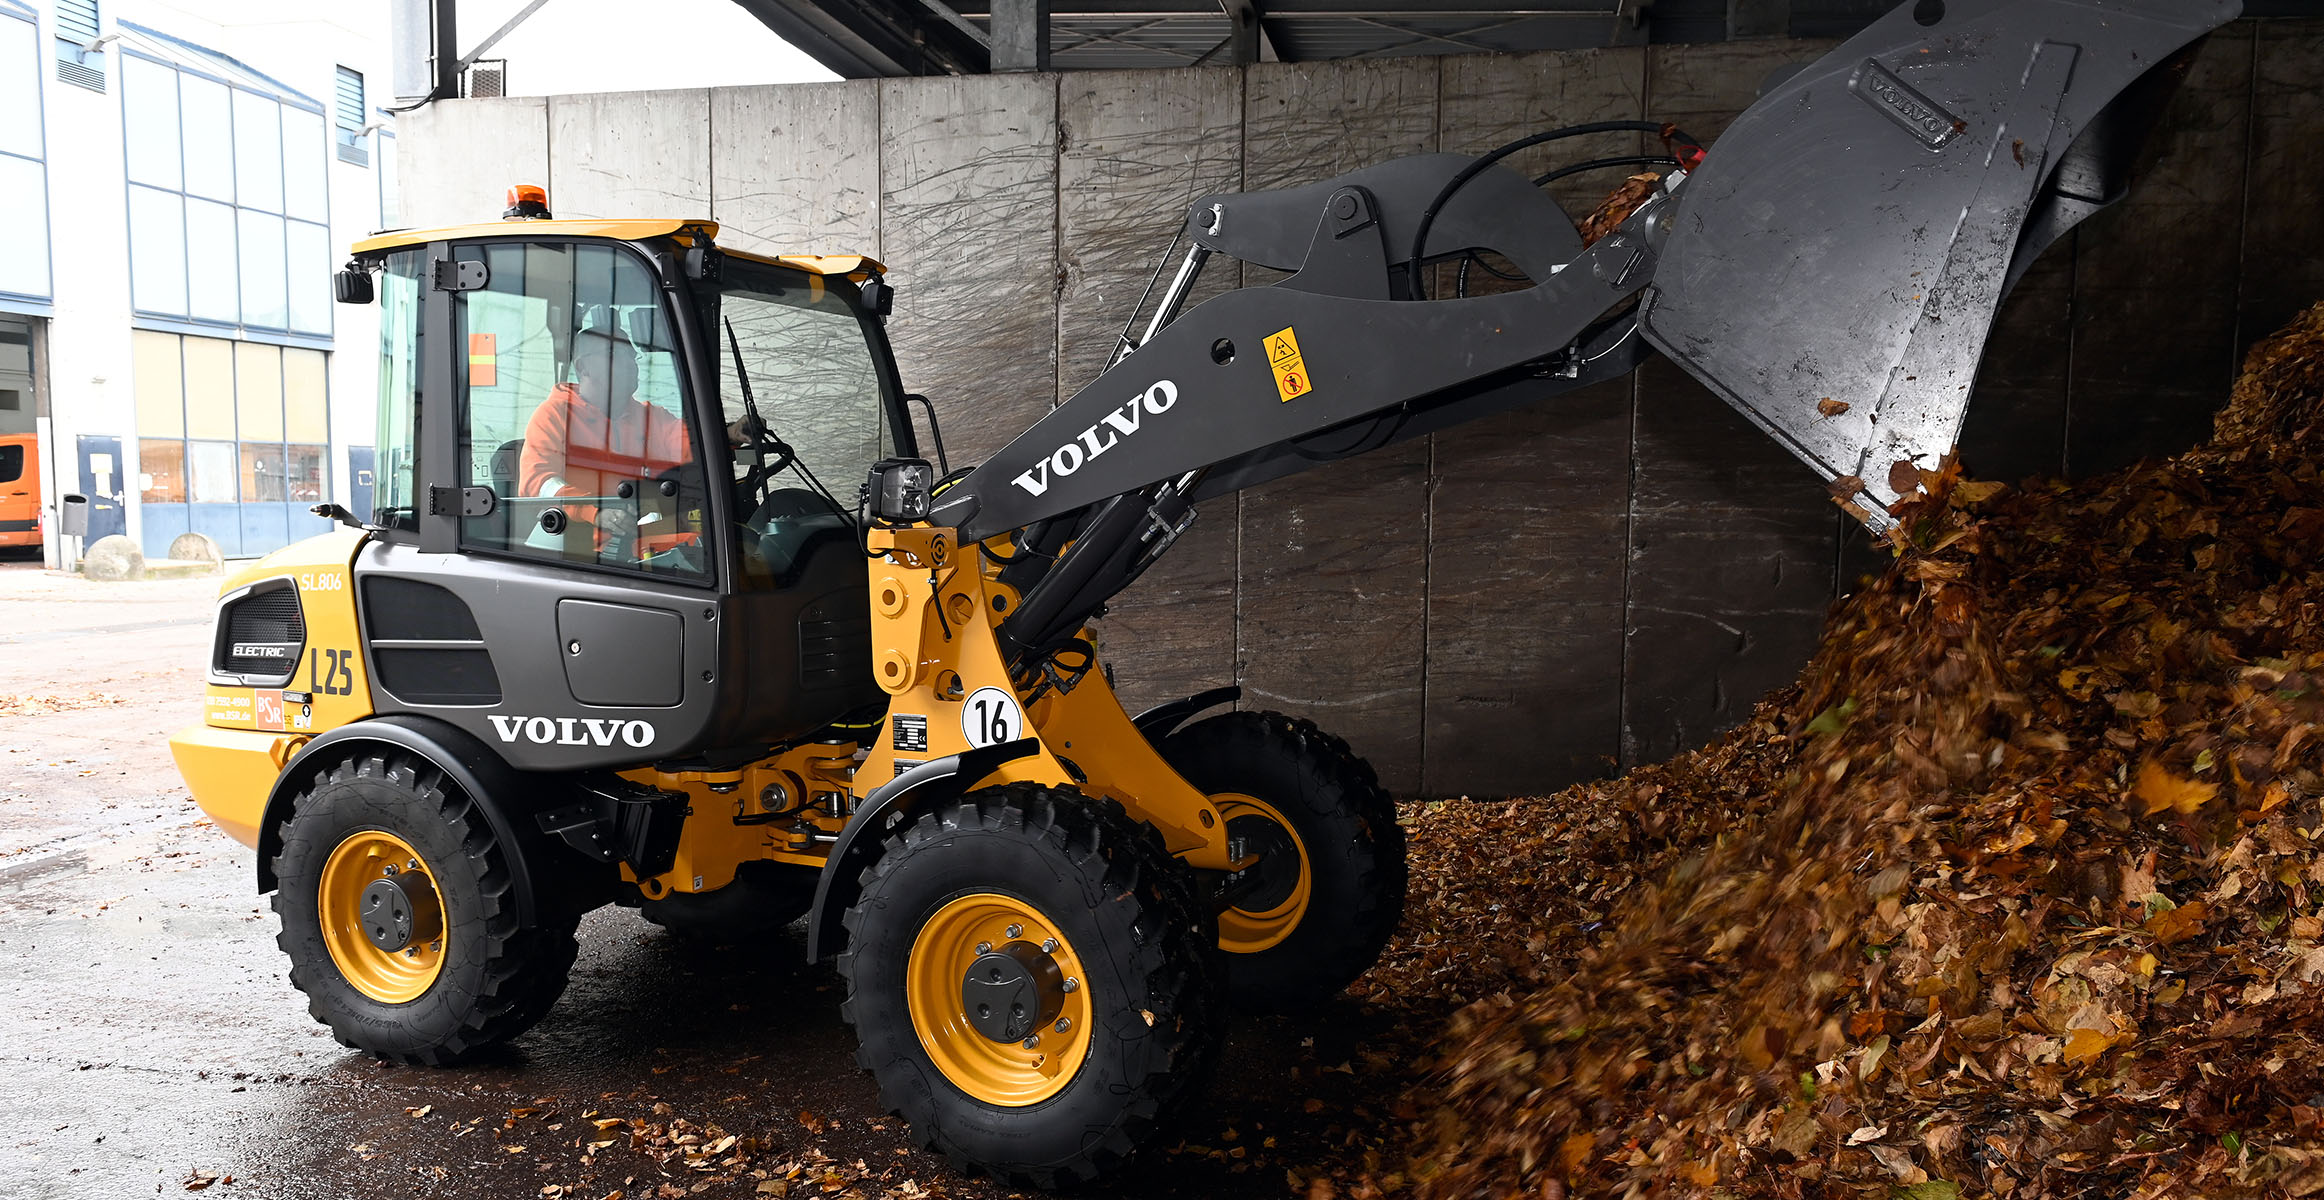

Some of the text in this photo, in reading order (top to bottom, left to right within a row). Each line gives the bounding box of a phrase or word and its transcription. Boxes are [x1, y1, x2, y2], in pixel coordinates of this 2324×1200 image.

[1869, 74, 1941, 132] VOLVO
[1011, 379, 1178, 498] VOLVO
[301, 573, 342, 591] SL806
[233, 646, 285, 657] ELECTRIC
[311, 648, 353, 696] L25
[257, 697, 281, 723] BSR
[975, 700, 1008, 744] 16
[488, 715, 655, 747] VOLVO
